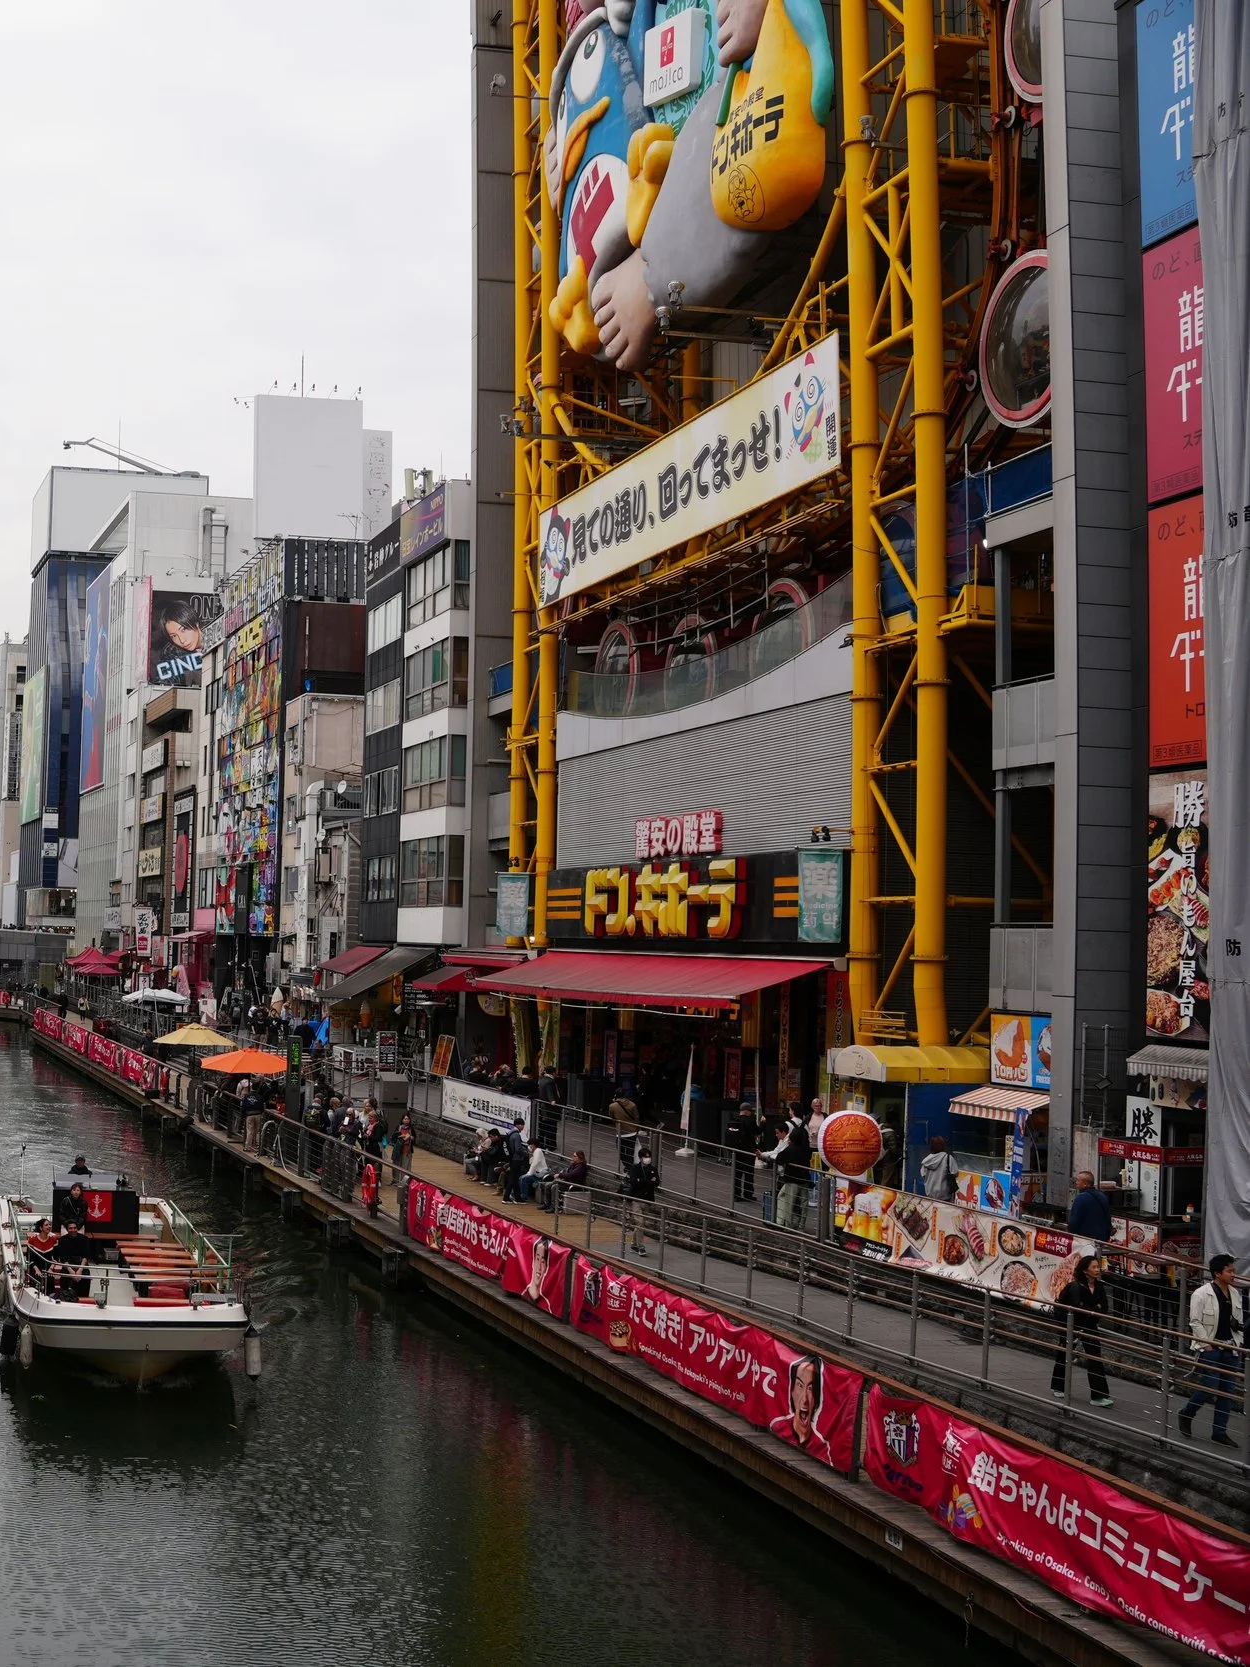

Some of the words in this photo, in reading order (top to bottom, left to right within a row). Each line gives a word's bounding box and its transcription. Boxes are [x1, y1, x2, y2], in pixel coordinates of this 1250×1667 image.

[635, 810, 717, 858] 驚安の殿堂
[1173, 780, 1205, 829] 勝
[803, 860, 840, 899] 薬
[1179, 841, 1197, 1018] 旨いもん屋台
[1131, 1106, 1159, 1141] 勝
[687, 1321, 778, 1399] アツアツやで
[966, 1449, 1250, 1618] 飴ちゃんはコミュニケー
[1034, 1549, 1046, 1566] of
[1116, 1596, 1147, 1624] Osaka
[1147, 1615, 1181, 1644] comes
[1181, 1633, 1207, 1655] with
